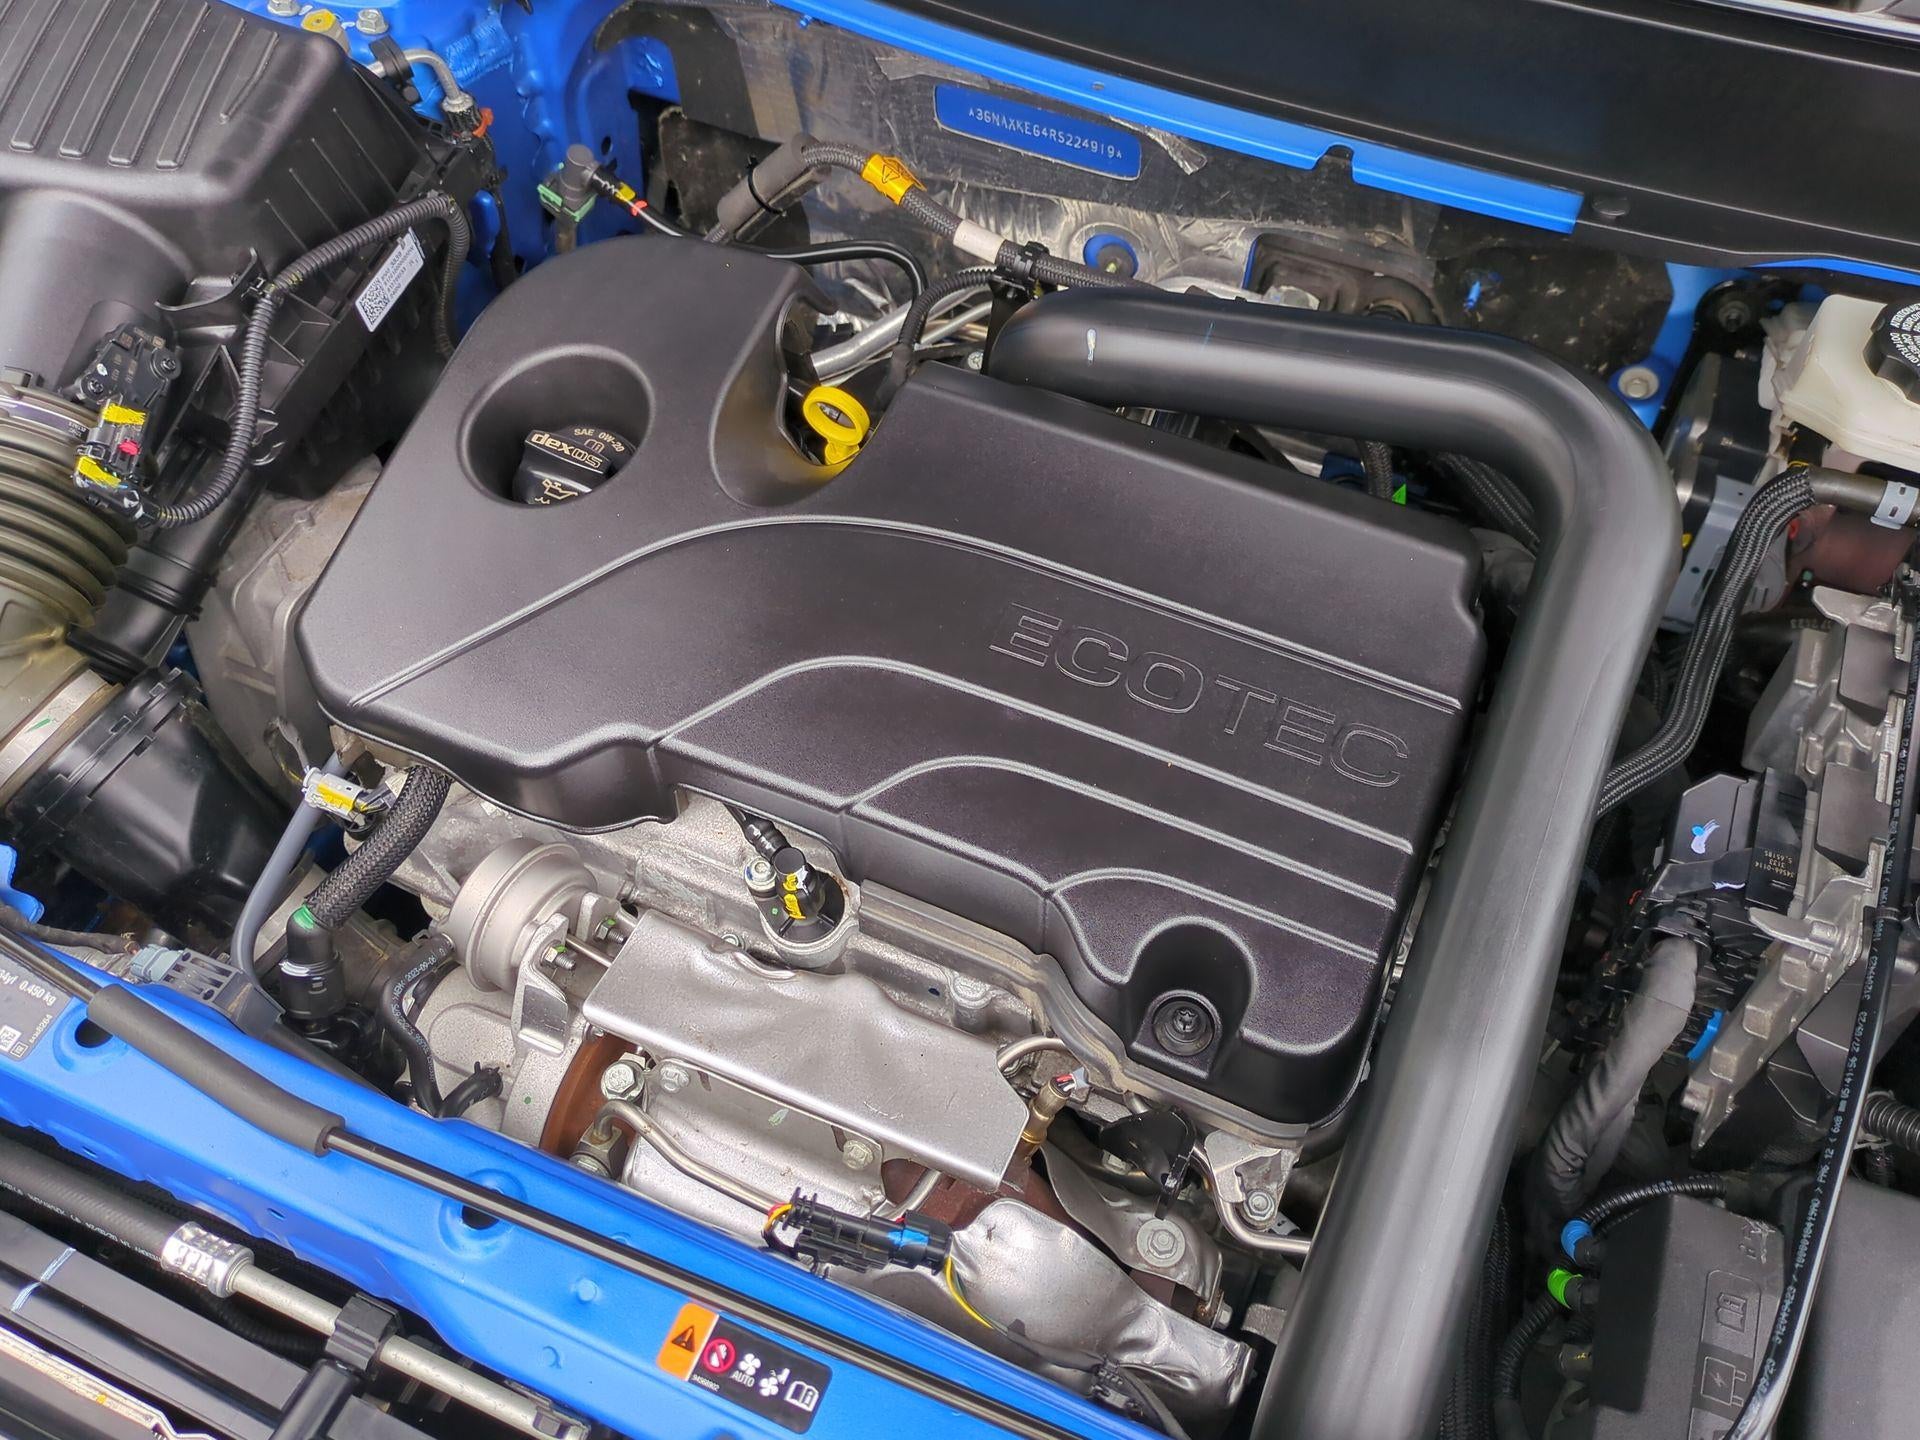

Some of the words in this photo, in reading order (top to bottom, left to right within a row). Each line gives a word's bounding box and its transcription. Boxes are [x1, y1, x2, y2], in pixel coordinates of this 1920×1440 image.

[531, 433, 603, 469] dexos
[574, 428, 595, 436] SAE
[599, 432, 625, 452] 0W-20
[989, 603, 1409, 788] ECOTEC
[19, 980, 46, 998] 0.450
[43, 991, 57, 1007] kg
[730, 1370, 756, 1387] AUTO
